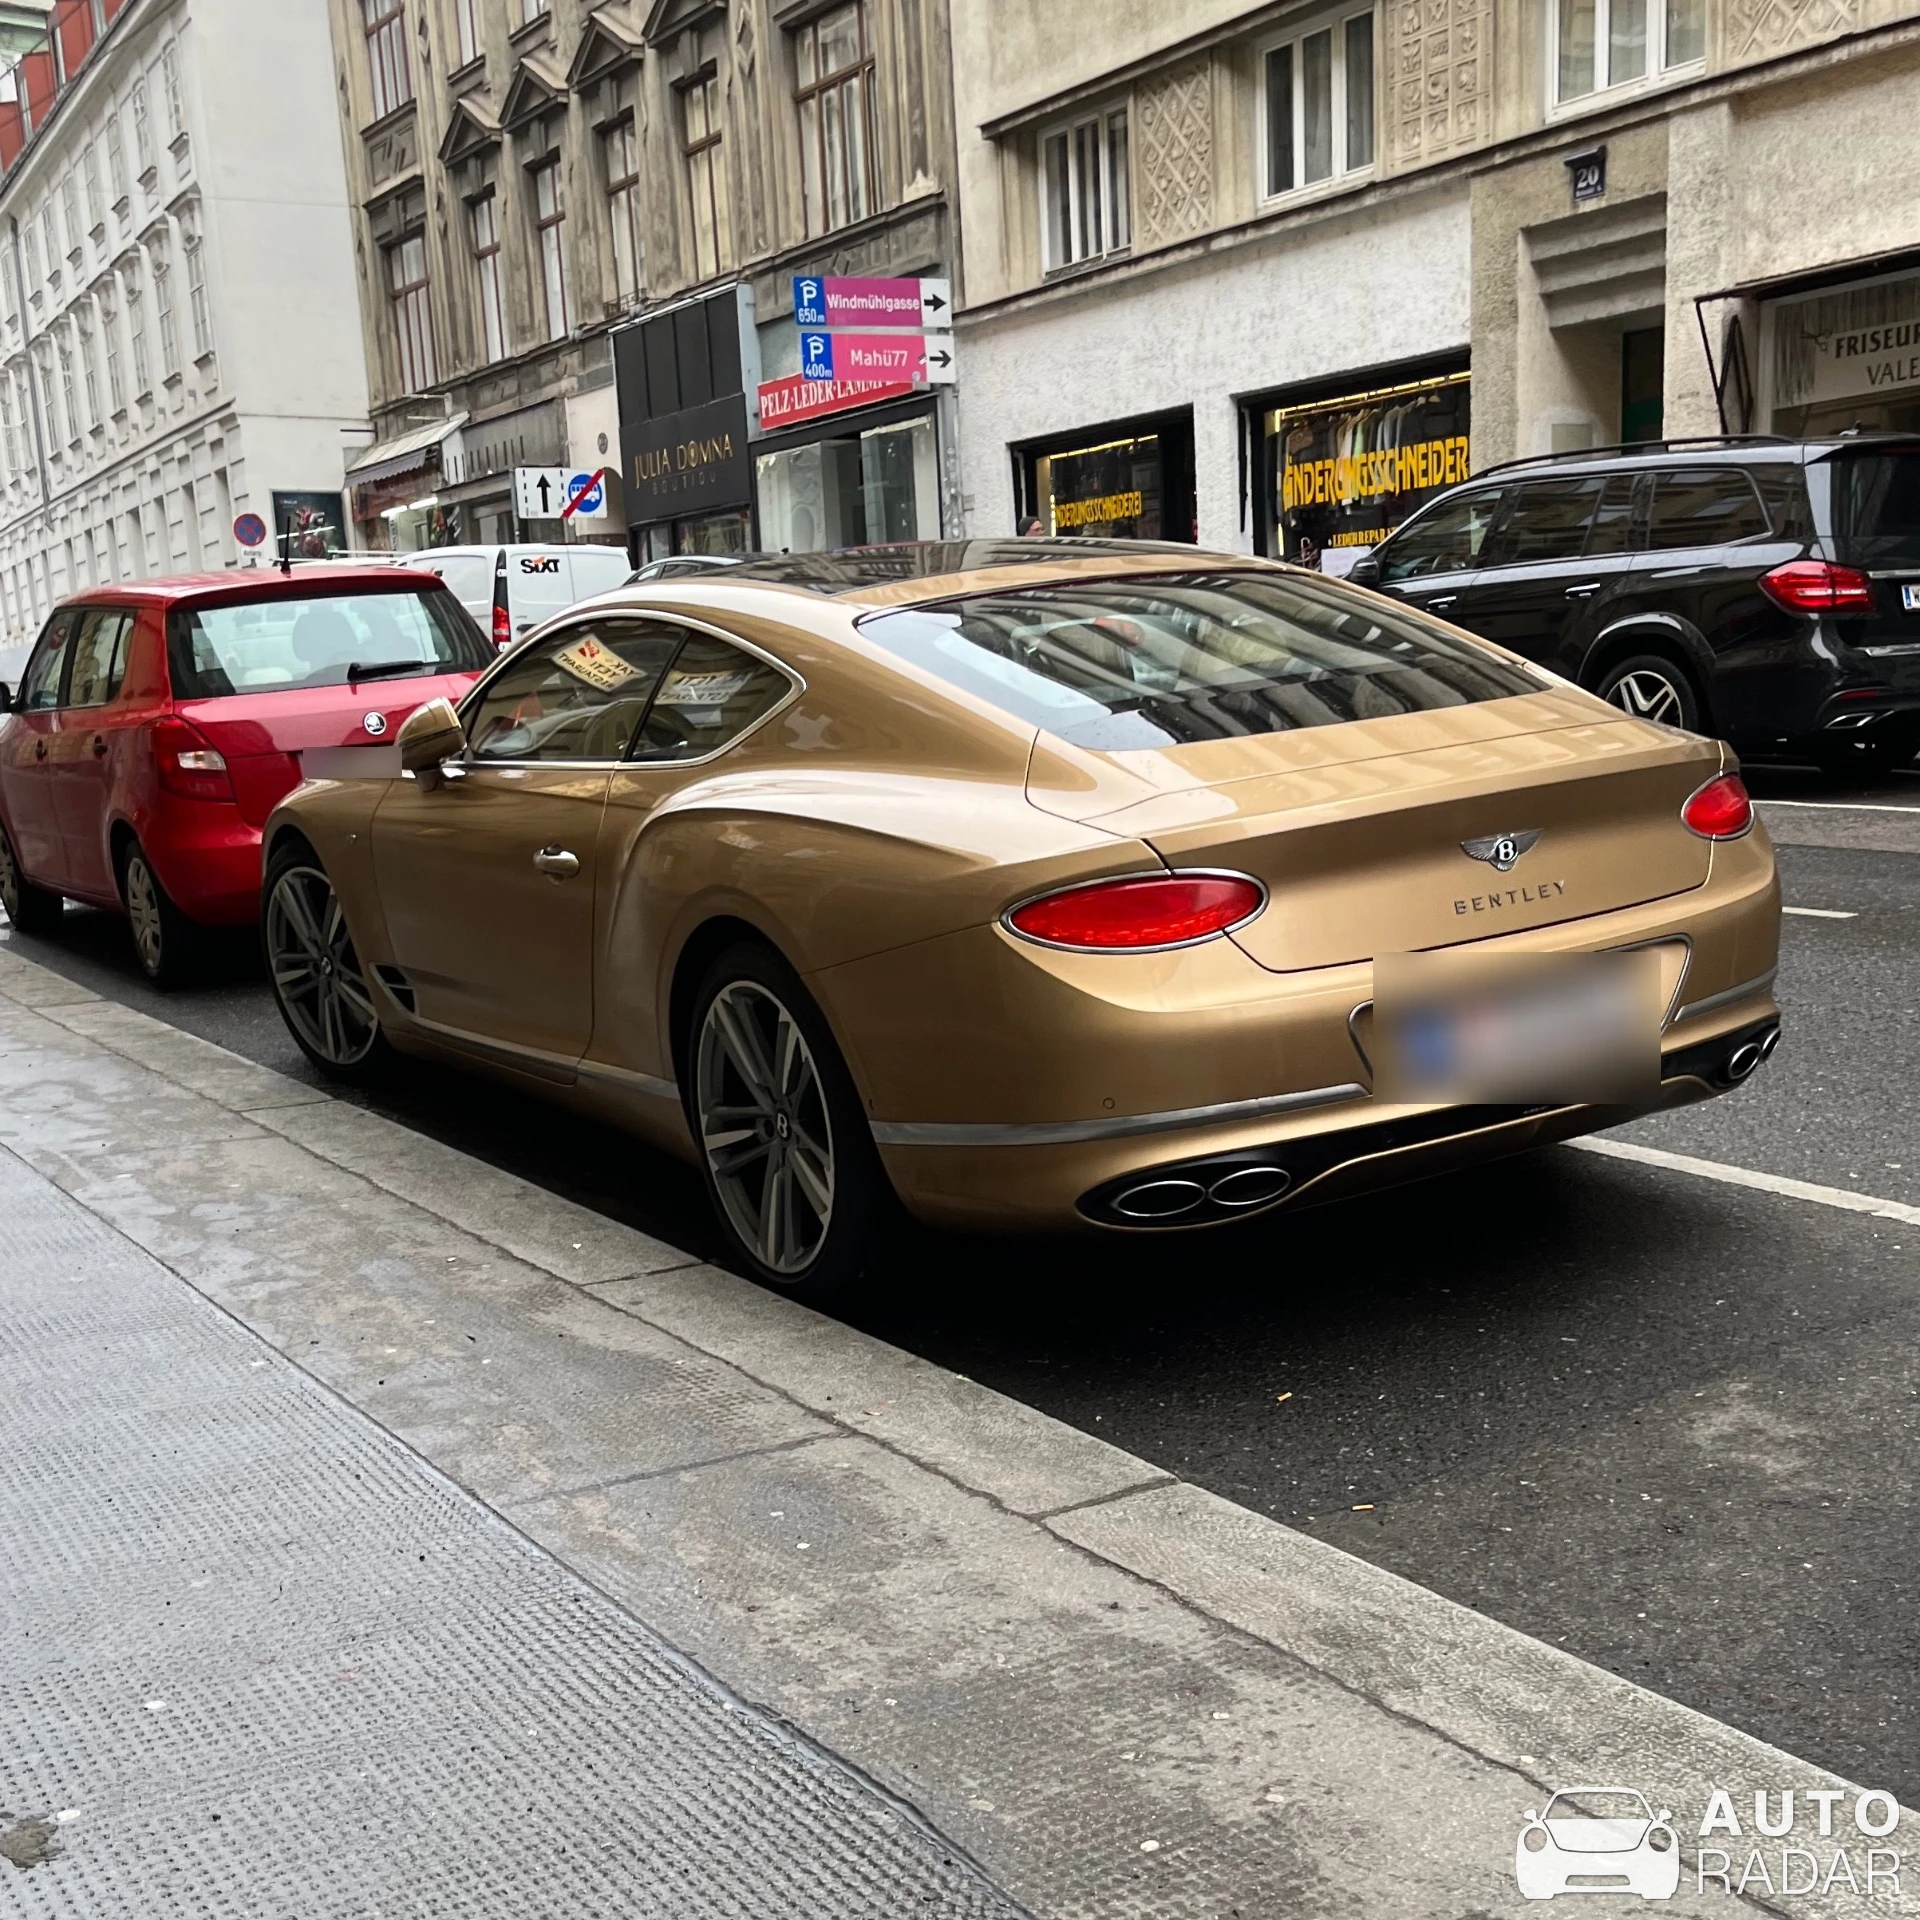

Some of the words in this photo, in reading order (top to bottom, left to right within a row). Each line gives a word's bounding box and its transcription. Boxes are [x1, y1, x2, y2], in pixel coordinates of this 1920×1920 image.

[1577, 166, 1600, 189] 20
[802, 286, 817, 307] P
[826, 293, 921, 313] Windmühlgasse
[809, 341, 824, 362] P
[851, 349, 908, 367] Mahü77
[1867, 357, 1920, 386] VALE
[635, 448, 671, 489] JULIA
[677, 433, 733, 470] DOMNA
[1499, 840, 1514, 861] B
[1454, 880, 1565, 915] BENTLEY
